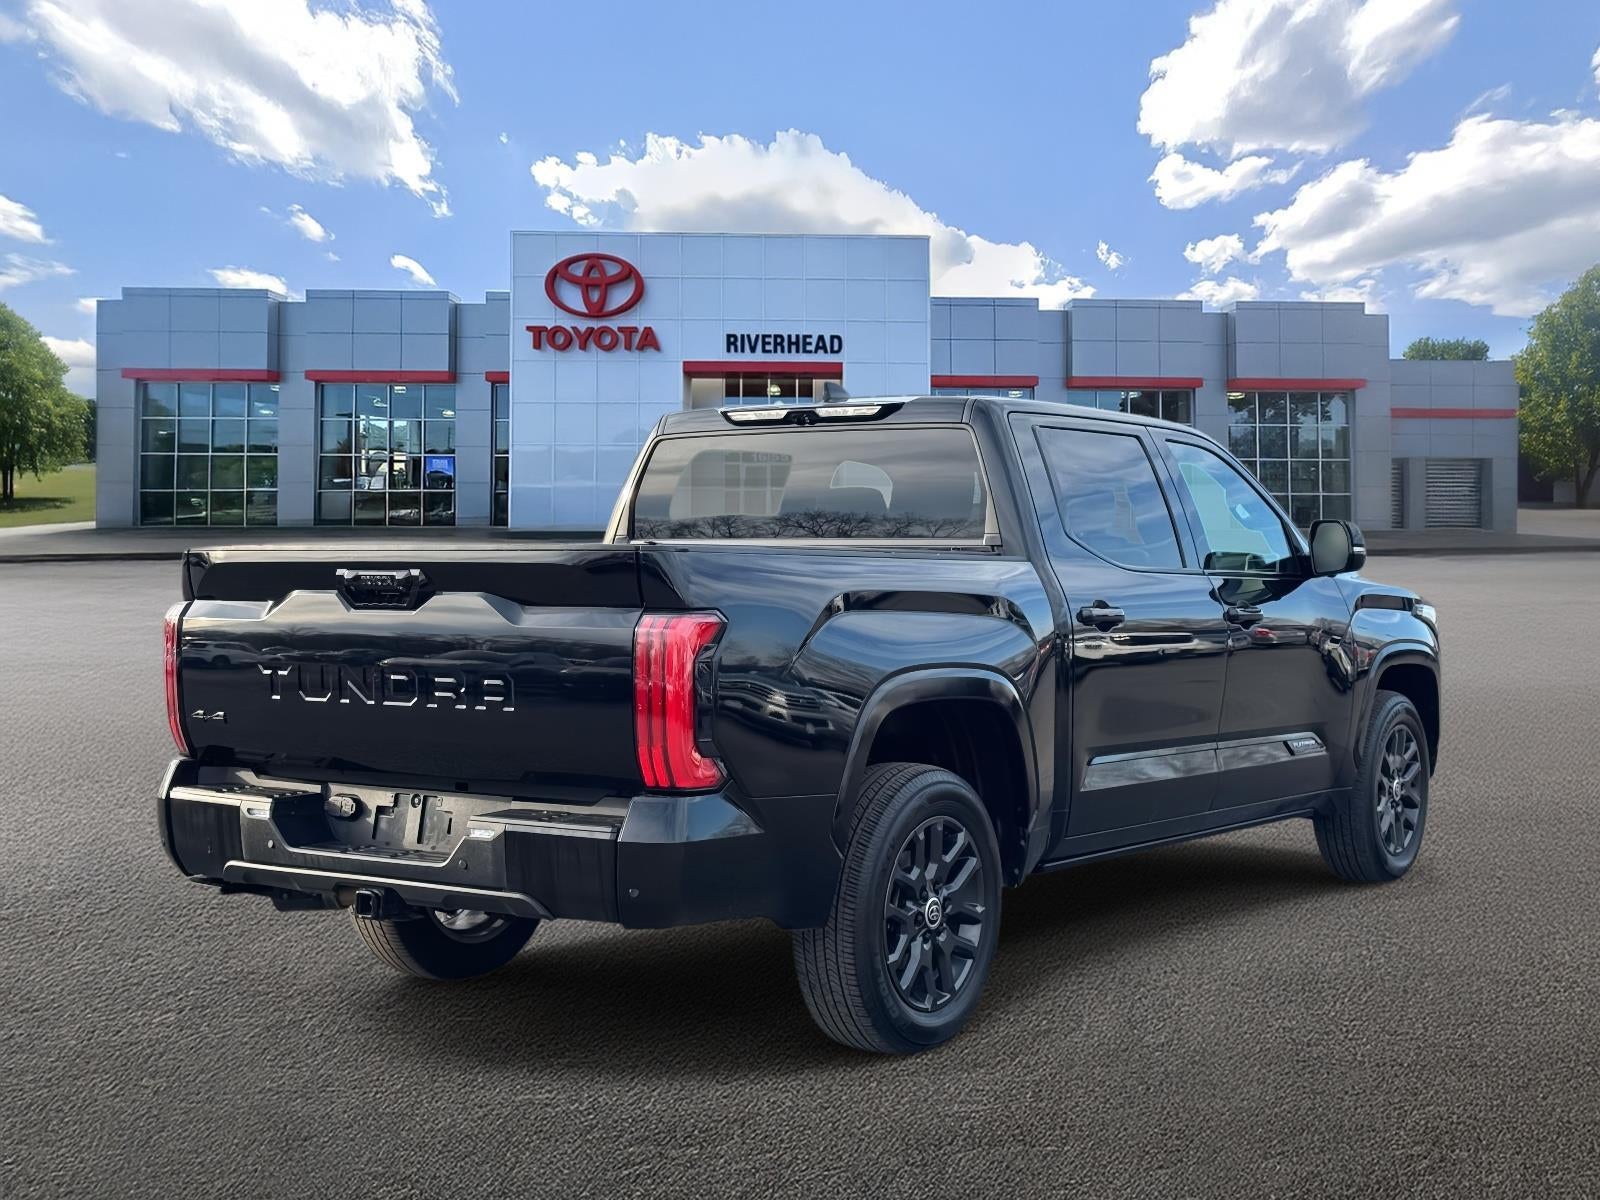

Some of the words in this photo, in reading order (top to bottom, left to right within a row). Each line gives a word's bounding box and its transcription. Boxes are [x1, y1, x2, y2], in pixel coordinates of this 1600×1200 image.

[526, 325, 661, 353] TOYOTA
[725, 333, 843, 355] RIVERHEAD
[257, 664, 515, 712] TUNDRA
